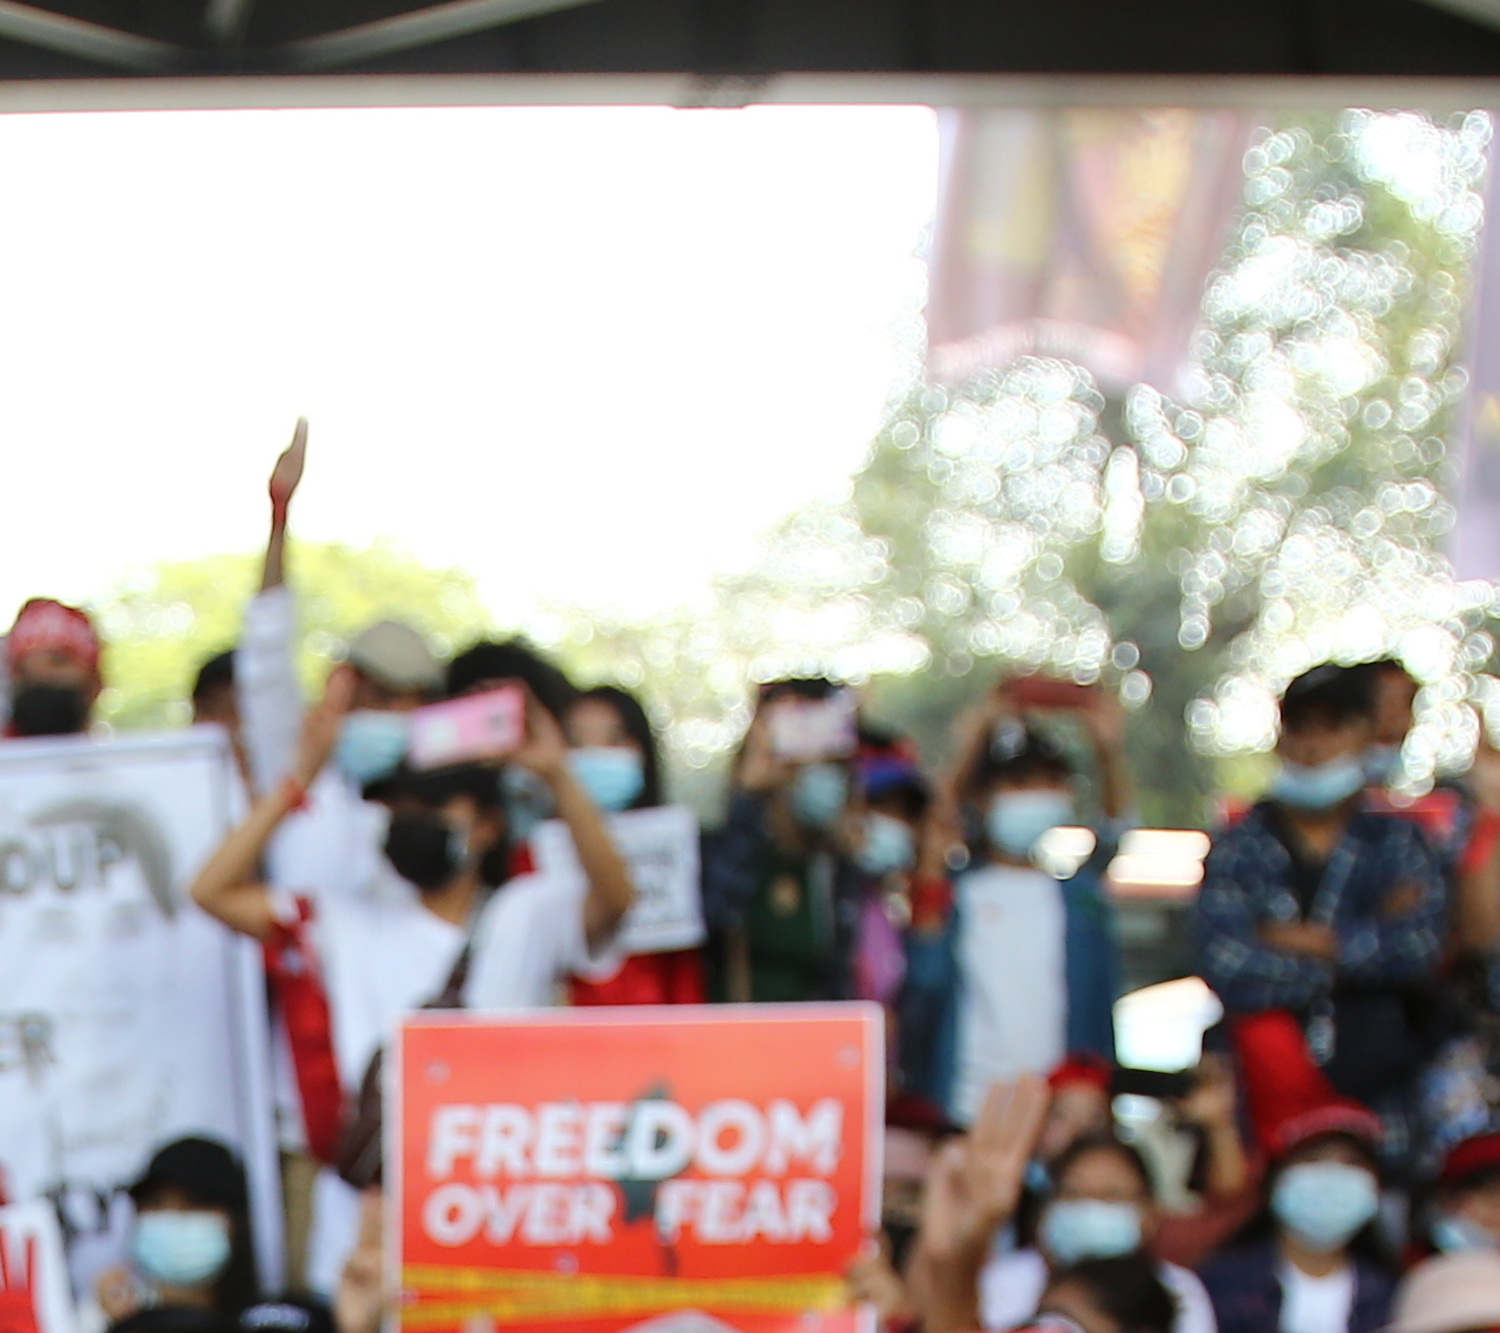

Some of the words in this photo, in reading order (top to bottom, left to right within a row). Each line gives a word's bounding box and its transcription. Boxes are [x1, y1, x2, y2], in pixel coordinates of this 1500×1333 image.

[426, 1098, 845, 1179] FREEDOM
[422, 1183, 615, 1247] OVER
[654, 1181, 840, 1248] FEAR
